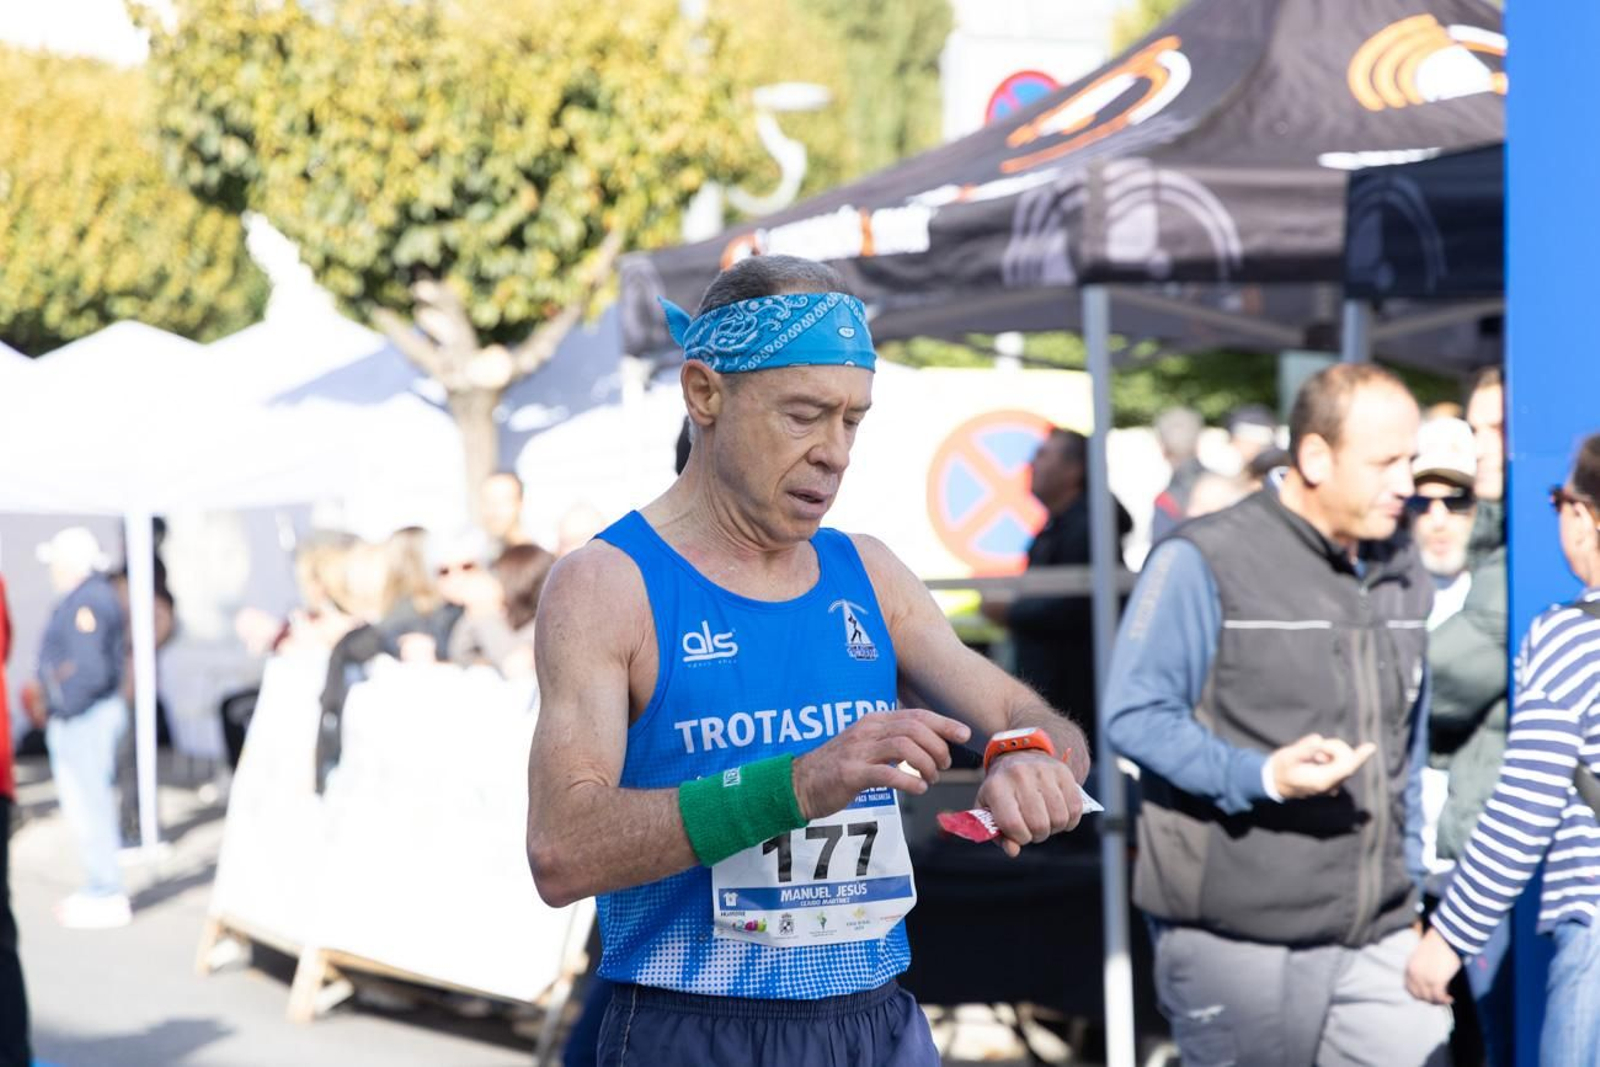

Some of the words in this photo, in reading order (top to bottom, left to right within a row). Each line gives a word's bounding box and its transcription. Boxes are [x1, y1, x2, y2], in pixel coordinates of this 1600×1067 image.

[683, 620, 738, 662] als
[674, 700, 896, 754] TROTASIER
[762, 821, 878, 883] 177
[780, 885, 831, 902] MANUEL
